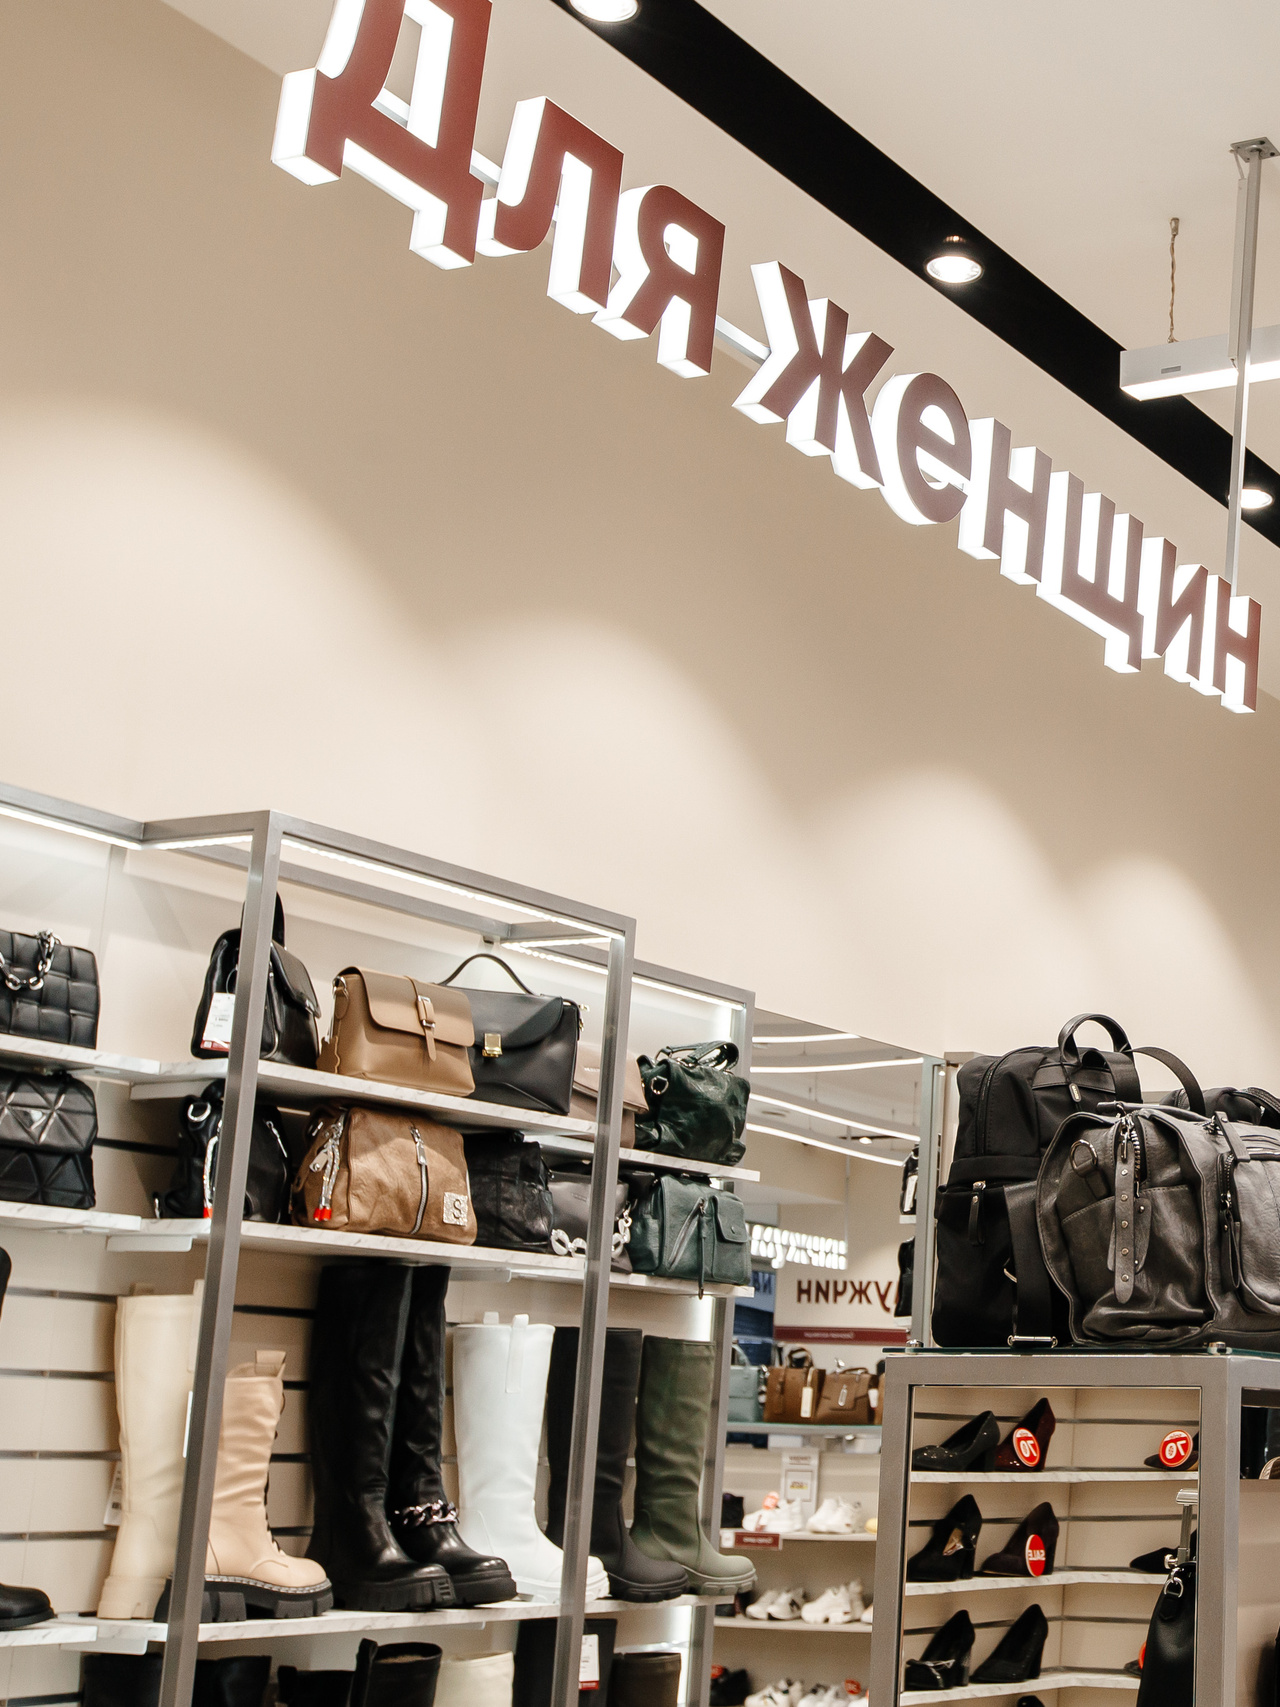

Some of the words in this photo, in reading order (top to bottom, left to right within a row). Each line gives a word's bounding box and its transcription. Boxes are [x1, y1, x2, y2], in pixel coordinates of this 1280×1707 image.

[271, 0, 725, 379] Для
[732, 261, 1262, 713] женщин
[453, 1198, 462, 1219] S
